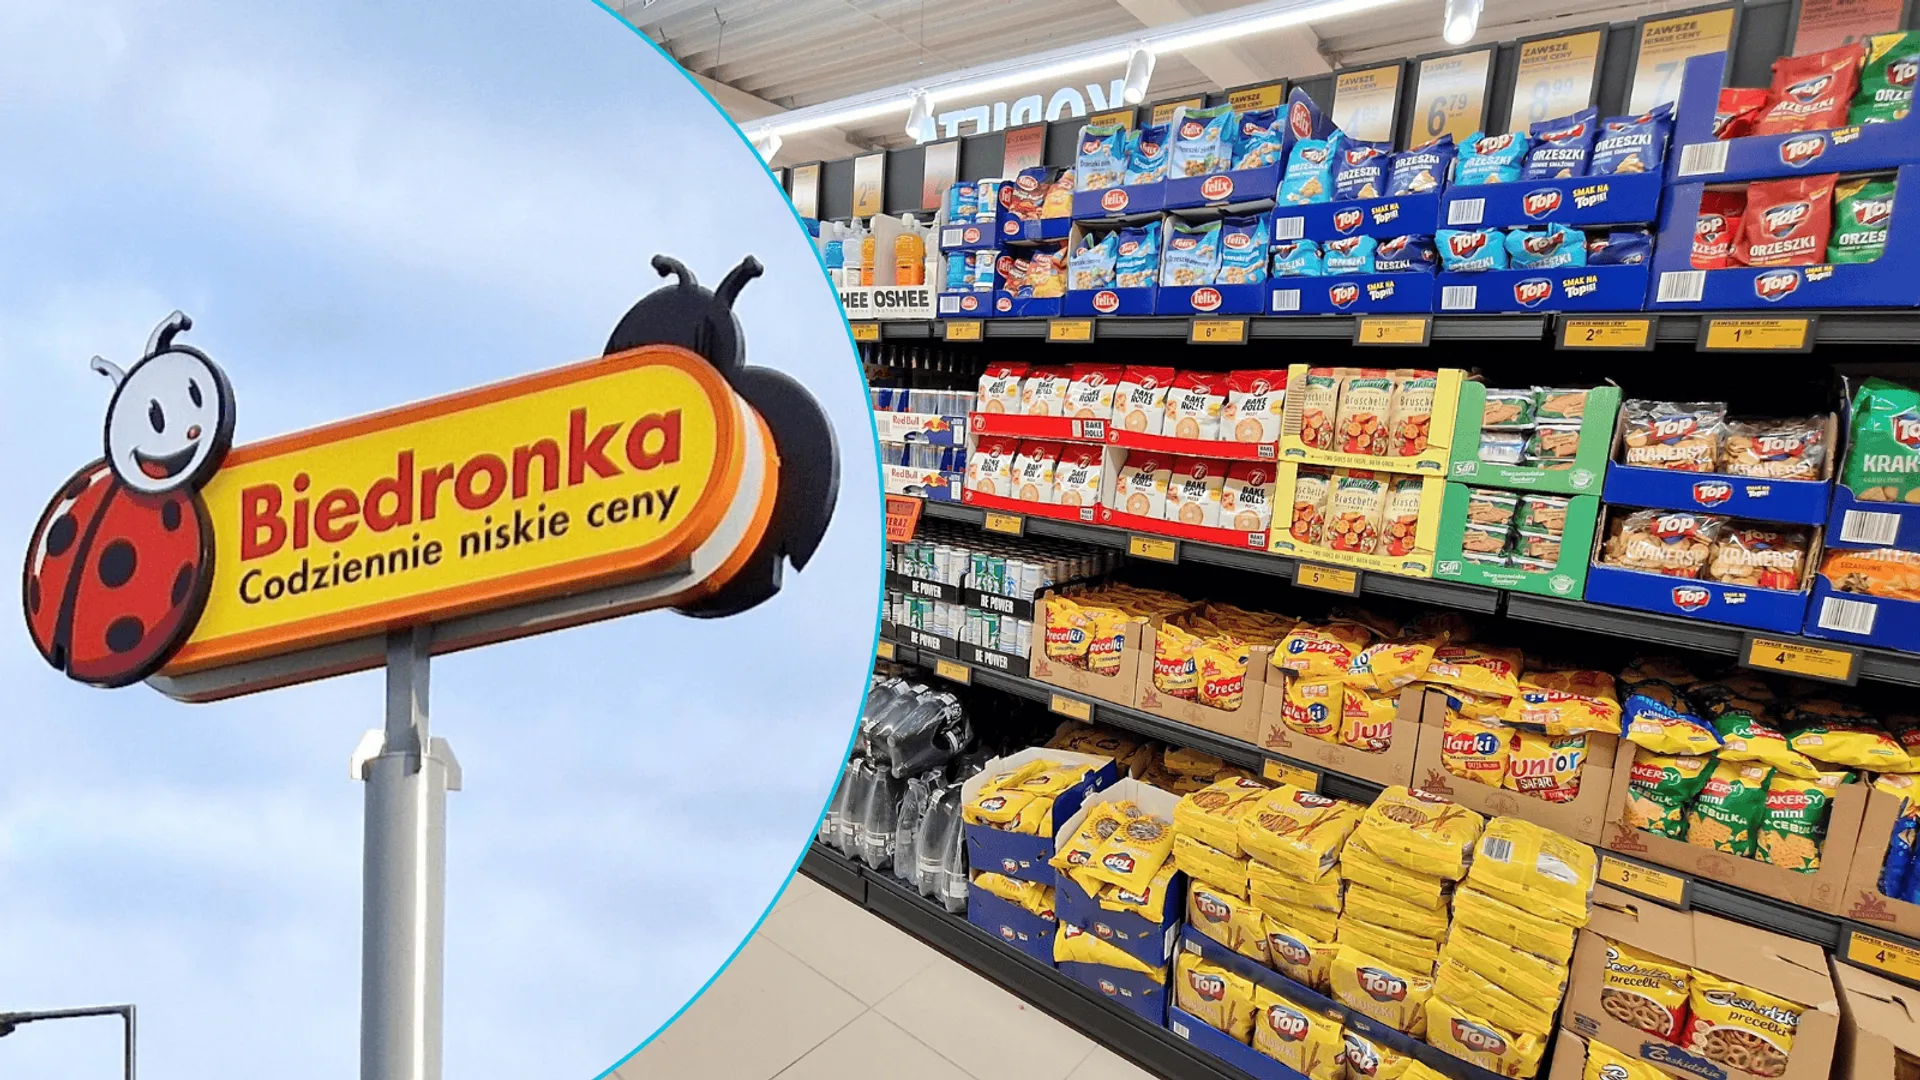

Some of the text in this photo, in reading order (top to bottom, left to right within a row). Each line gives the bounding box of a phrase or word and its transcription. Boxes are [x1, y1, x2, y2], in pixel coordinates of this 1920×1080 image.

[1646, 21, 1698, 36] ZAWSZE
[1643, 31, 1702, 45] NISKIE CENY
[1523, 43, 1569, 57] ZAWSZE
[1522, 52, 1573, 64] NISKIE CENY
[1339, 75, 1375, 86] ZAWSZE
[1788, 78, 1829, 96] Top
[1230, 94, 1261, 104] ZAWSZE
[1292, 104, 1310, 134] felix
[1427, 94, 1467, 137] 6 79
[1595, 134, 1652, 151] ORZESZKI
[1788, 138, 1822, 159] Top
[1395, 154, 1439, 168] ORZESZKI
[1464, 155, 1511, 169] ORZESZKI
[1532, 148, 1585, 161] ORZESZKI
[1338, 166, 1381, 182] ORZESZKI
[859, 184, 867, 207] 2
[1203, 180, 1230, 197] felix
[1572, 184, 1609, 198] SMAK NA
[1104, 192, 1127, 207] felix
[1529, 192, 1556, 210] Top
[1371, 202, 1399, 215] SMAK NA
[1337, 210, 1360, 226] Top
[1767, 204, 1809, 230] Top
[1225, 235, 1248, 248] felix
[1454, 233, 1479, 251] Top
[1750, 236, 1816, 257] ORZESZKI
[1367, 280, 1395, 292] SMAK NA
[1563, 275, 1598, 287] SMAK NA
[1761, 274, 1793, 294] Top
[1334, 285, 1355, 302] Top
[1520, 281, 1547, 300] Top
[873, 290, 930, 308] OSHEE
[1094, 294, 1116, 308] felix
[1191, 290, 1221, 307] felix
[1206, 327, 1212, 338] 6
[1376, 327, 1384, 339] 3
[1585, 328, 1595, 341] 2
[1734, 329, 1742, 342] 1
[1184, 394, 1206, 405] BAKE
[1245, 397, 1267, 407] BAKE
[1241, 403, 1266, 412] ROLLS
[893, 415, 919, 426] Red Bull
[1085, 421, 1101, 429] BAKE
[1654, 418, 1695, 437] Top
[1085, 428, 1103, 438] ROLLS
[1759, 437, 1800, 452] Top
[1627, 445, 1708, 463] KRAKERSY
[1455, 463, 1475, 475] San
[1863, 454, 1919, 473] KRAK
[892, 468, 917, 479] Red Bull
[1134, 472, 1154, 482] BAKE
[239, 407, 682, 562] Biedronka
[1185, 480, 1208, 491] BAKE
[1242, 486, 1265, 497] BAKE
[1240, 493, 1265, 504] ROLLS
[1699, 486, 1726, 500] Top
[1657, 516, 1695, 533] Top
[1743, 529, 1778, 542] Top
[238, 484, 680, 606] Codziennie niskie ceny
[1142, 543, 1148, 553] 5
[1718, 547, 1800, 569] KRAKERSY
[1439, 562, 1459, 574] San
[1312, 572, 1319, 583] 5
[911, 581, 942, 599] BE POWER
[1678, 590, 1705, 604] Top
[980, 594, 1014, 614] BE POWER
[910, 631, 941, 650] BE POWER
[1755, 639, 1823, 655] ZAWSZE NISKIE CENY
[975, 649, 1008, 669] BE POWER
[1775, 651, 1785, 664] 4
[1786, 652, 1796, 660] 99
[1344, 721, 1393, 743] Jun
[1444, 735, 1491, 752] larki
[1510, 751, 1580, 778] unior
[1277, 768, 1284, 778] 3
[1520, 776, 1553, 789] SAFARI
[1299, 792, 1333, 805] Top
[1700, 795, 1725, 805] mini
[1766, 794, 1821, 805] AKERSY
[1698, 804, 1748, 826] CEBULKA
[1771, 808, 1804, 819] mini
[1773, 820, 1826, 835] CEBULKA
[1104, 855, 1134, 872] Top
[1604, 857, 1661, 878] ZAWSZE NISKIE CENY
[1621, 870, 1631, 883] 3
[1199, 899, 1227, 917] Top
[1274, 938, 1306, 960] Top
[1854, 932, 1884, 946] ZAWSZE
[1884, 940, 1905, 951] NISKIE
[1875, 949, 1897, 964] 4 99
[1193, 975, 1221, 995] Top
[1365, 974, 1402, 996] Top
[1610, 975, 1661, 989] precelki
[1270, 1010, 1305, 1033] Top
[1728, 1010, 1788, 1038] precelki
[1458, 1024, 1501, 1051] Top
[1345, 1041, 1377, 1070] Top
[1648, 1046, 1721, 1080] Beskidzkie
